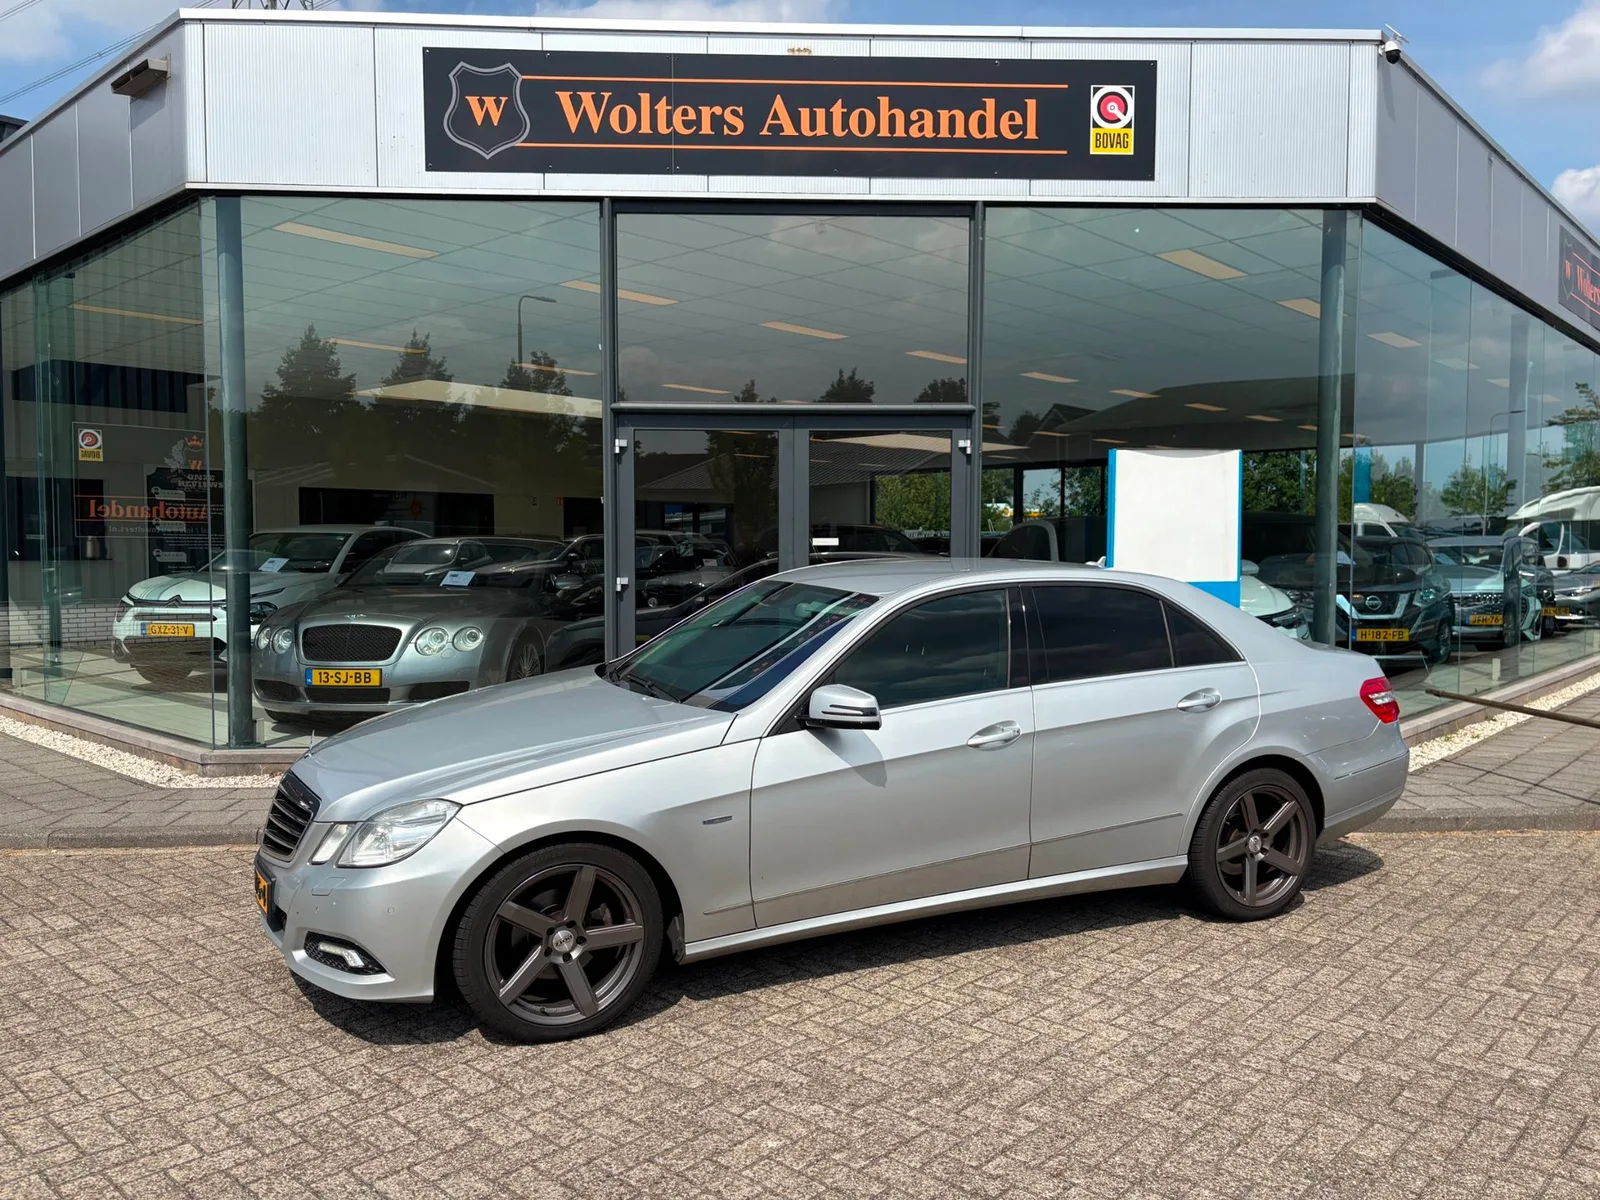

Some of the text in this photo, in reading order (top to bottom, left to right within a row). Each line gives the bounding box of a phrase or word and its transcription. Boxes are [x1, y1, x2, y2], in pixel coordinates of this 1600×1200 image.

[465, 96, 508, 126] W
[555, 91, 1039, 140] Wolters Autohandel
[1094, 133, 1130, 150] BOVAG
[150, 624, 189, 635] GXZ-31-V
[1360, 630, 1404, 640] H-182-FB
[318, 671, 372, 684] 13-SJ-BB
